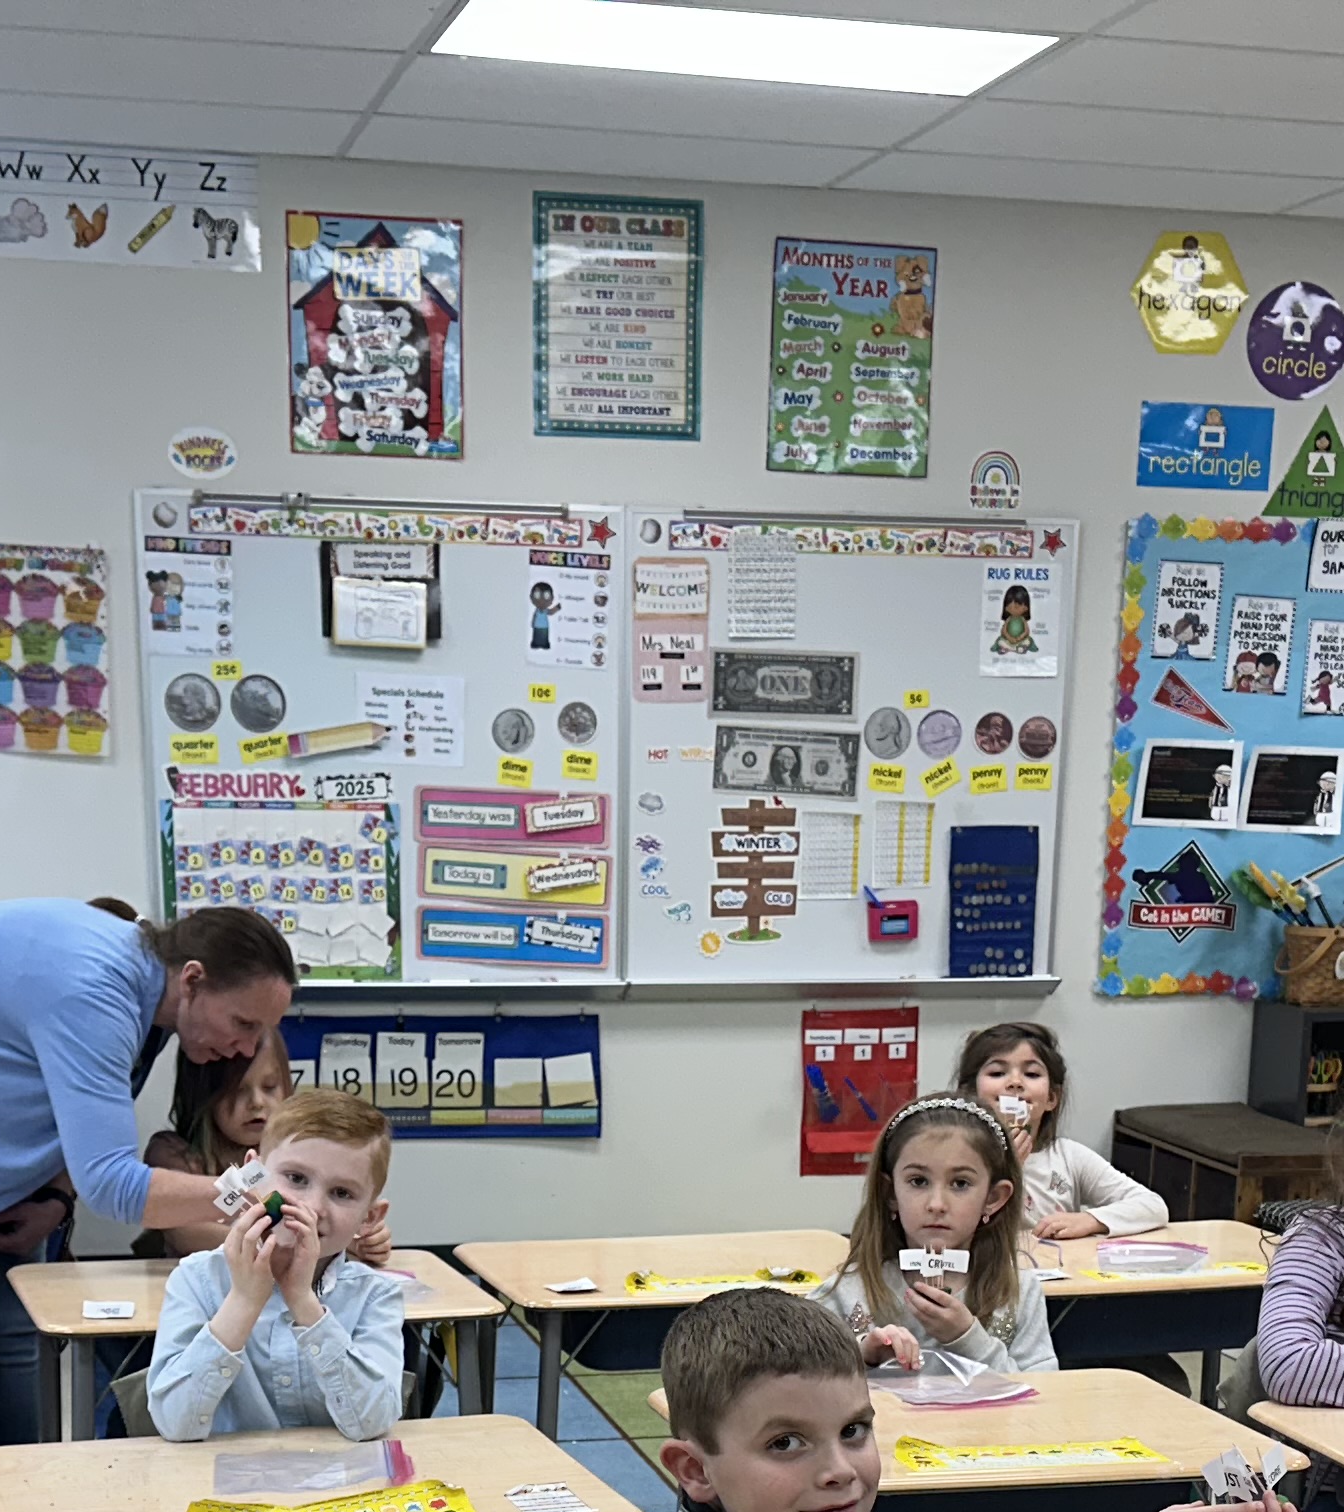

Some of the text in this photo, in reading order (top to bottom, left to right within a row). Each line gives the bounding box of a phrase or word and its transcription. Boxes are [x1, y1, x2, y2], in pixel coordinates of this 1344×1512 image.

[66, 153, 101, 184] Xx
[130, 157, 167, 198] Yy
[199, 162, 227, 192] Zz
[552, 214, 684, 237] IN OUR CLASS
[781, 247, 854, 269] MONTHS
[336, 271, 417, 297] WEEK
[832, 272, 888, 298] YEAR
[780, 290, 828, 303] January
[352, 312, 403, 328] Sunday
[787, 314, 839, 332] February
[783, 342, 822, 354] March
[861, 342, 907, 357] August
[796, 363, 827, 379] April
[854, 366, 916, 381] September
[1262, 353, 1327, 380] circle
[339, 376, 401, 390] Wednesday
[783, 391, 813, 406] May
[857, 390, 908, 404] October
[853, 419, 913, 431] November
[366, 429, 420, 448] Saturday
[850, 448, 913, 461] December
[1148, 449, 1261, 486] rectangle
[987, 568, 1049, 580] RUG RULES
[635, 581, 707, 597] WELCOME
[1172, 576, 1207, 588] FOLLOW
[1161, 588, 1217, 600] DIRECTIONS
[1264, 613, 1288, 622] YOUR
[1265, 623, 1281, 631] FOR
[670, 637, 694, 650] Neal
[1233, 632, 1287, 642] PERMISSION
[216, 664, 237, 676] 25¢
[760, 675, 810, 694] ONE
[172, 740, 214, 751] quarter
[243, 735, 282, 753] quarter
[565, 754, 592, 768] dime
[648, 750, 668, 760] HOT
[502, 759, 528, 775] dime
[873, 767, 903, 778] nickel
[925, 762, 952, 784] nickel
[972, 767, 1002, 781] penny
[1018, 767, 1049, 778] penny
[176, 772, 300, 799] FEBRUARY
[335, 780, 375, 796] 2025
[431, 807, 584, 824] Yesterday was Tuesday
[735, 837, 782, 849] WINTER
[448, 867, 594, 884] Today Wednesday
[641, 885, 669, 895] COOL
[766, 893, 791, 904] COLD
[1140, 908, 1226, 924] Get the GAME!
[430, 925, 584, 943] Tomorrow will be Thursday
[388, 1036, 415, 1048] Today
[437, 1037, 482, 1047] Tomorrow
[333, 1068, 362, 1097] 18
[390, 1067, 418, 1097] 19
[435, 1069, 476, 1098] 20
